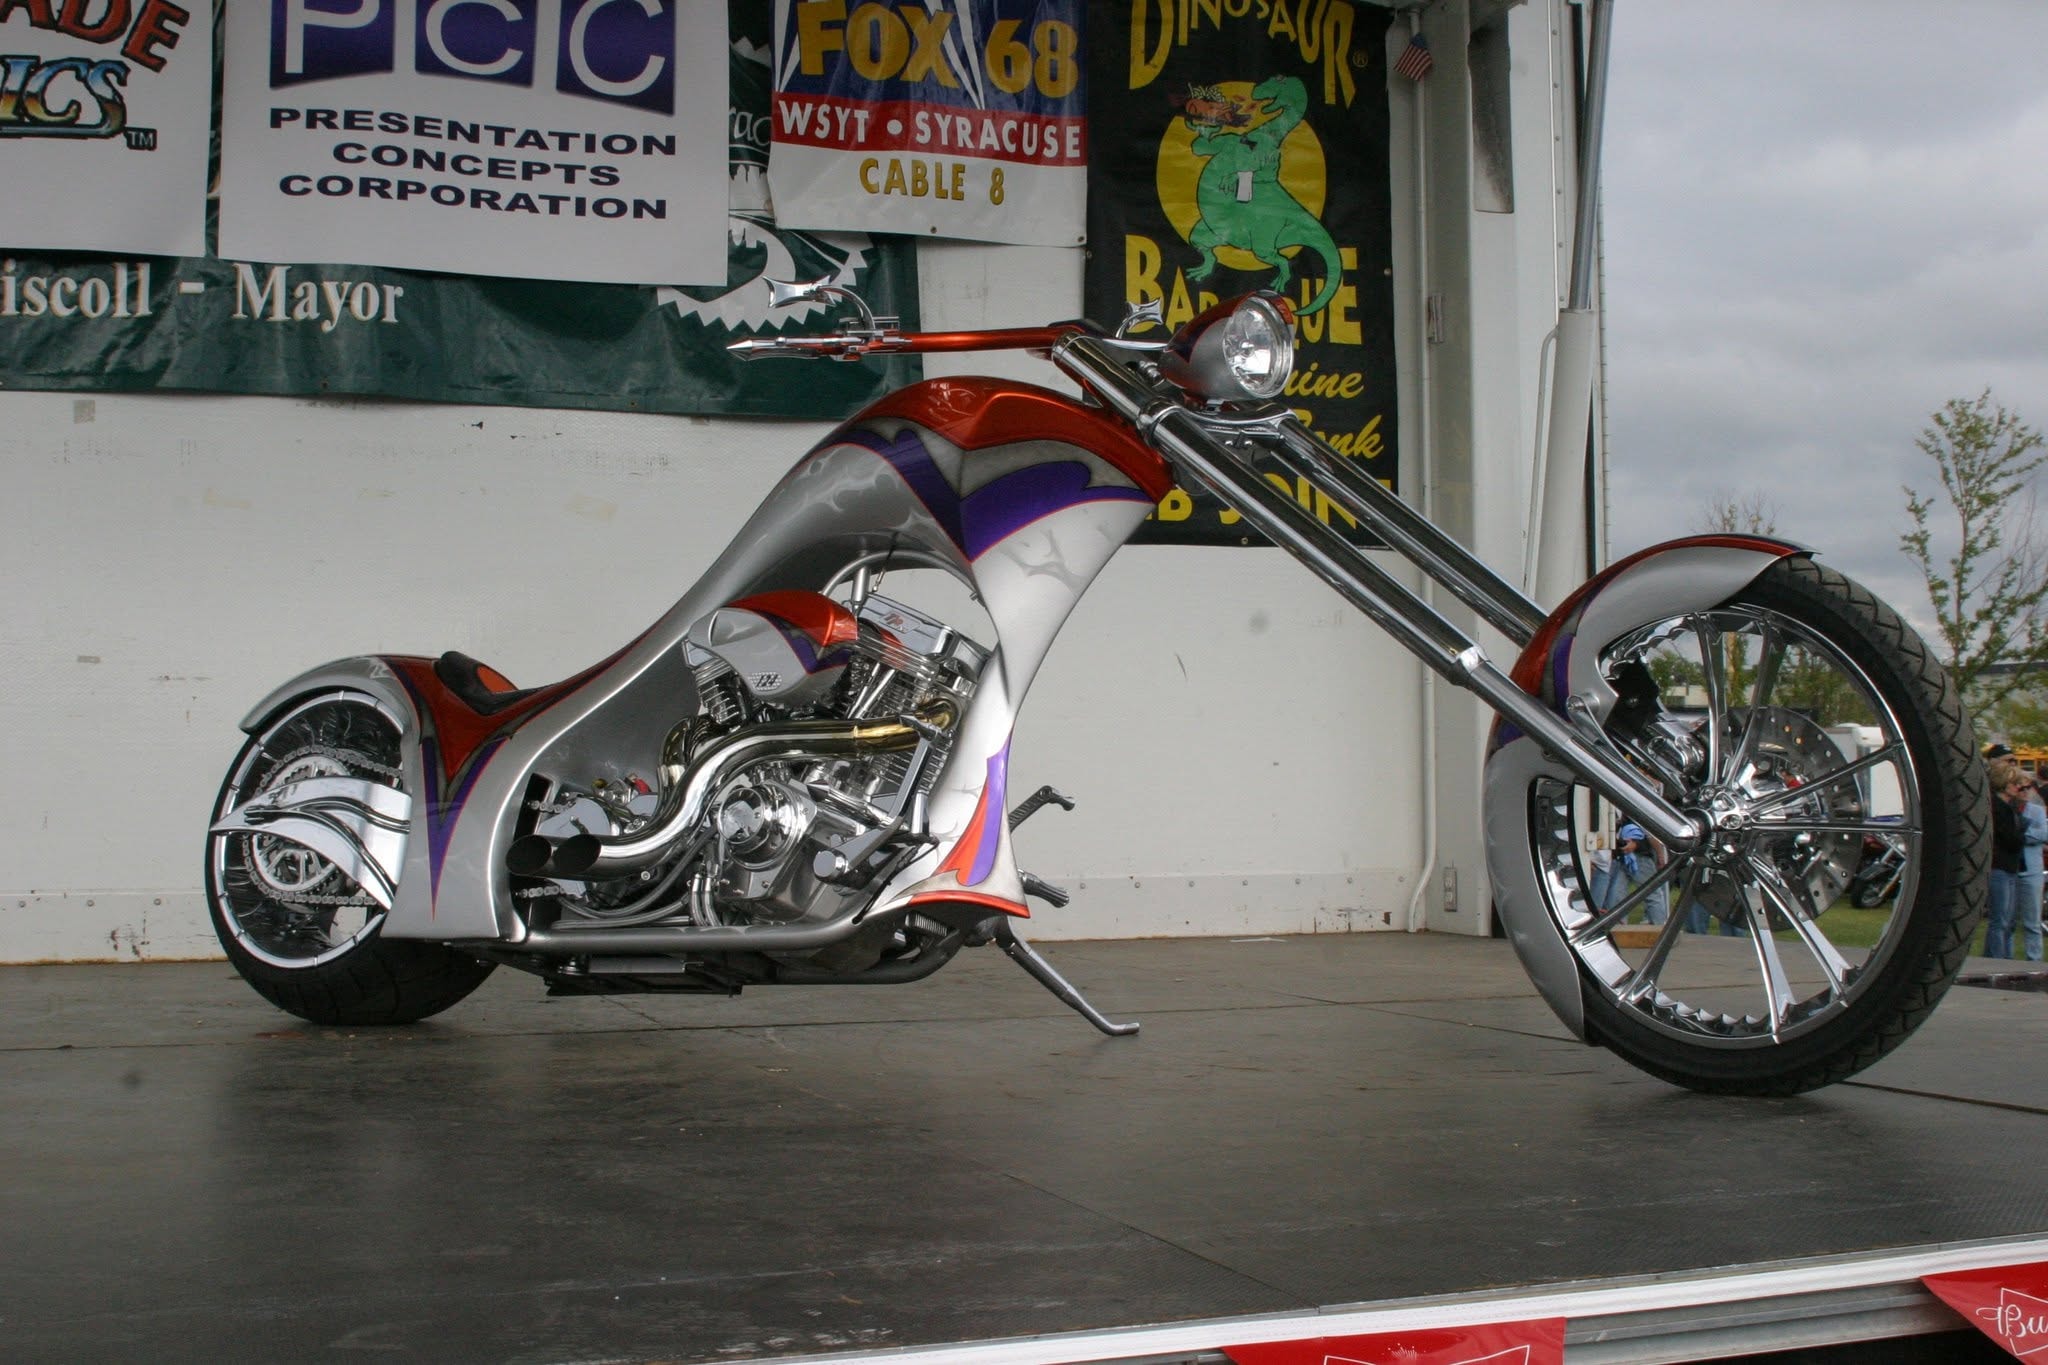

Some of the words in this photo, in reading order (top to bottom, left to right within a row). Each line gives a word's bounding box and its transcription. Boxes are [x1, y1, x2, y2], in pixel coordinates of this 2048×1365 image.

[798, 0, 960, 89] FOX
[984, 19, 1079, 98] 68
[1129, 0, 1356, 110] DINOSAUR
[269, 107, 677, 156] PRESENTATION
[778, 100, 869, 143] WSYT
[914, 110, 1081, 158] SYRACUSE
[332, 142, 621, 187] CONCEPTS
[858, 157, 966, 201] CABLE
[988, 167, 1005, 206] 8
[279, 174, 667, 220] CORPORATION
[0, 258, 152, 319] iscoll
[232, 263, 404, 334] Mayor
